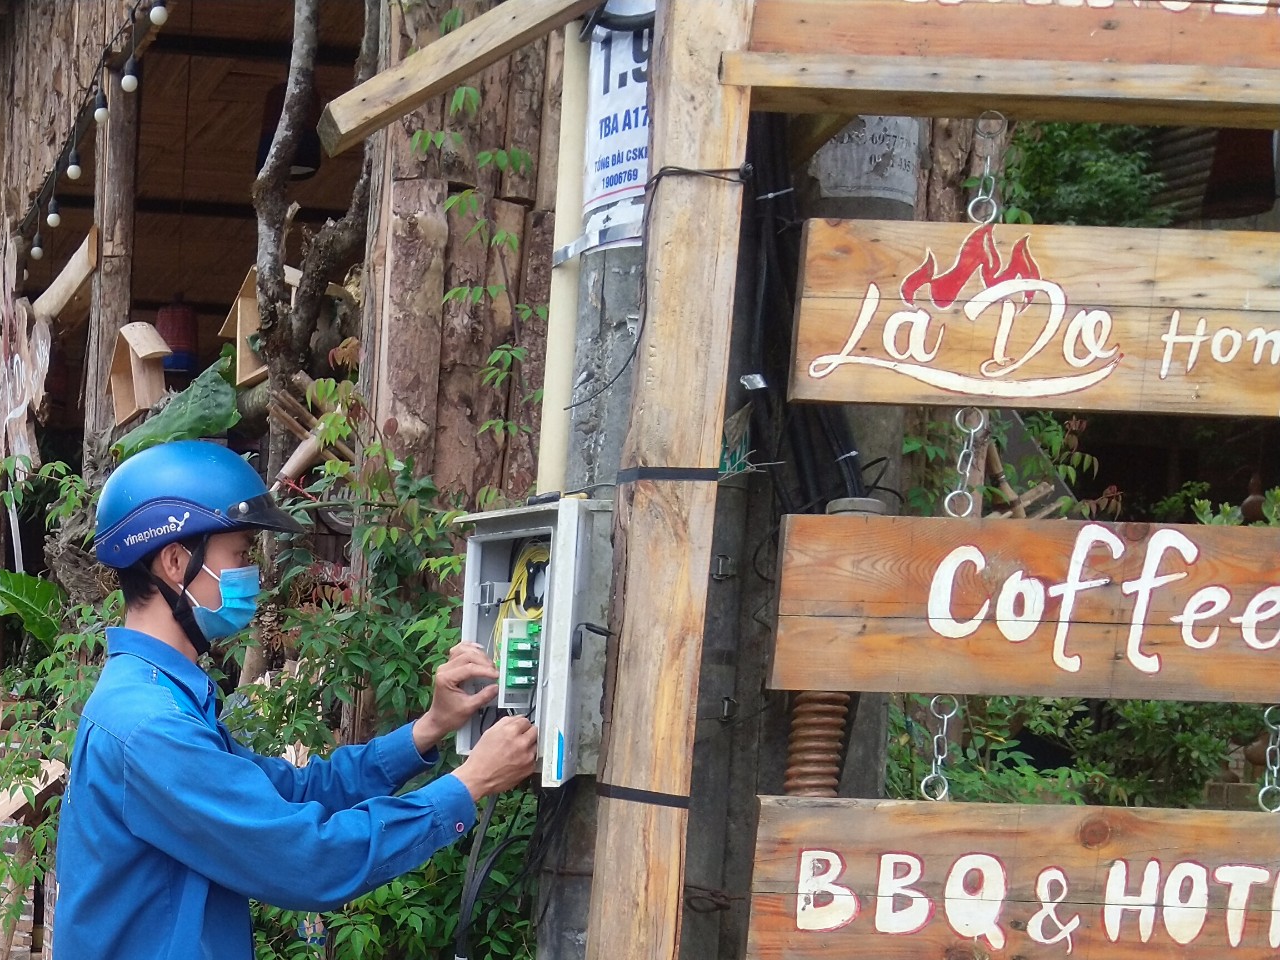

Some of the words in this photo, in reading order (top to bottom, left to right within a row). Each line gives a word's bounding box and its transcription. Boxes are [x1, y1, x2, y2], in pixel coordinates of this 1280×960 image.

[599, 113, 619, 140] TBA
[602, 168, 639, 189] 19006769
[808, 281, 947, 379] La
[963, 278, 1122, 378] Do
[123, 522, 177, 546] vinaphone
[927, 522, 1280, 674] Coffee
[795, 848, 1009, 950] BBQ
[1025, 865, 1081, 955] &
